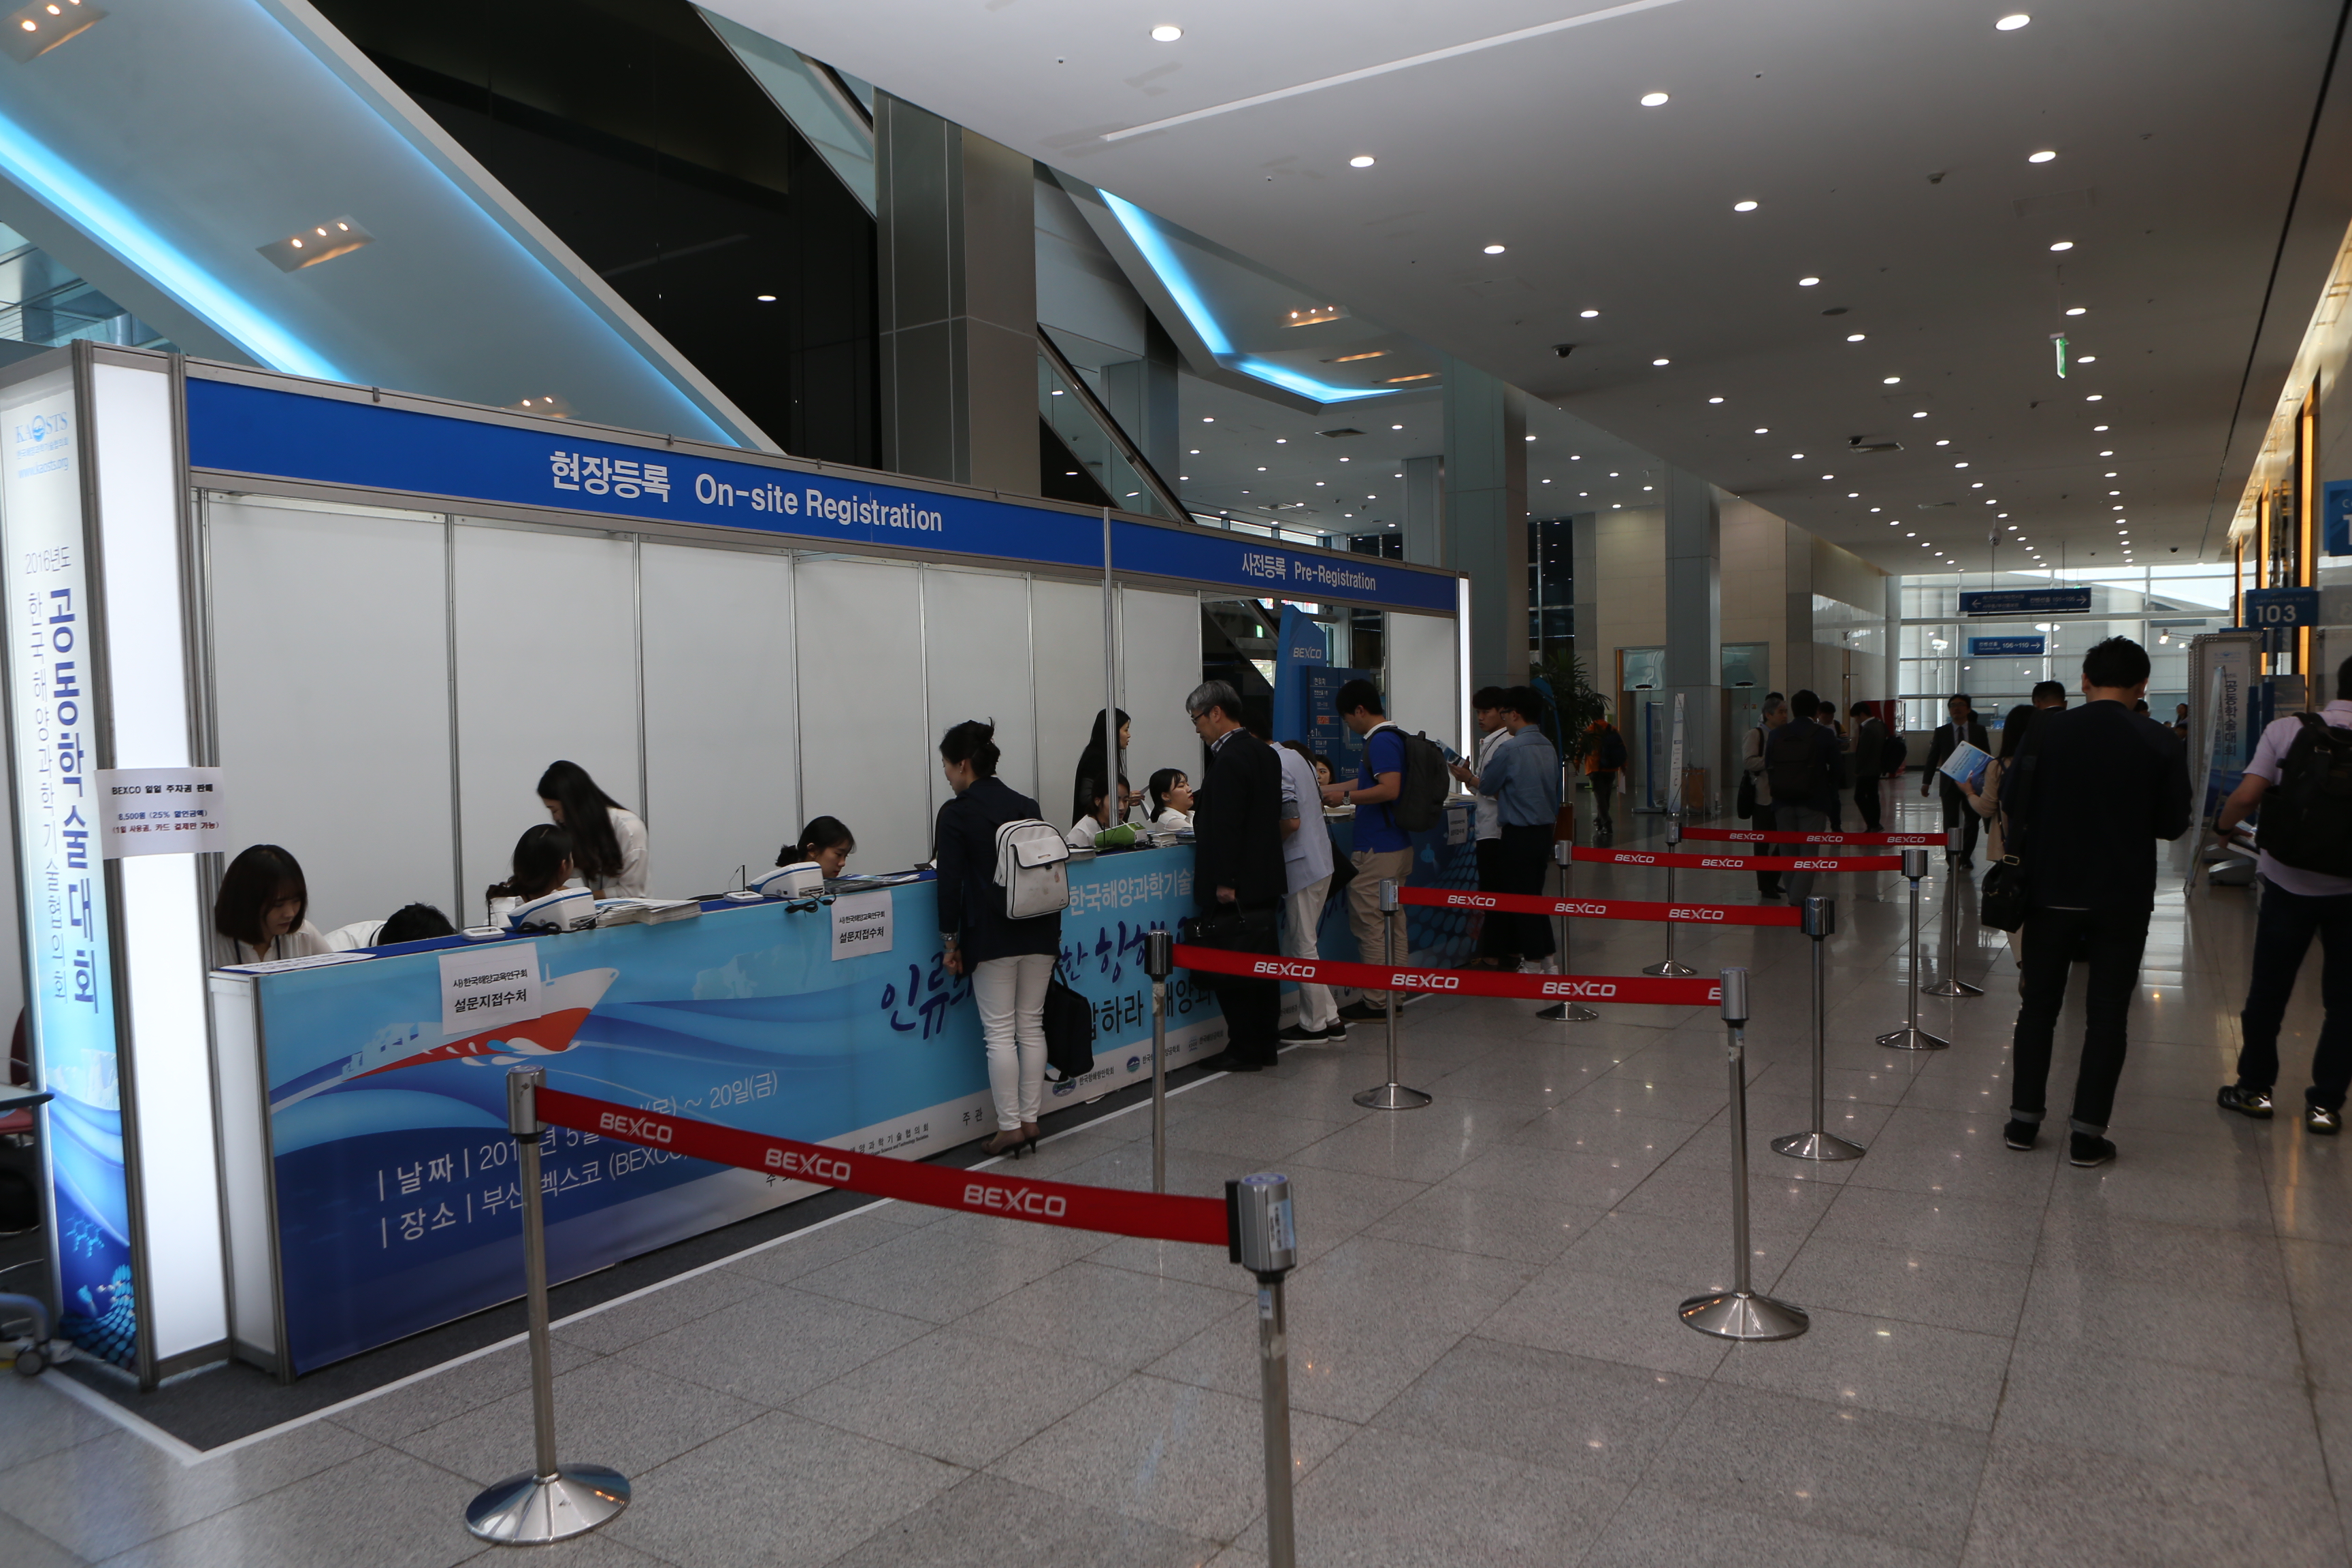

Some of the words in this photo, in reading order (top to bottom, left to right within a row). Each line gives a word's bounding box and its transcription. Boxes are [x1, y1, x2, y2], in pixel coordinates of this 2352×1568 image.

[15, 412, 68, 443] KAOSTS
[550, 450, 671, 503] 현장등록
[695, 473, 798, 515] On-site
[806, 488, 943, 532] Registration
[25, 546, 71, 575] 2016년도
[1242, 552, 1286, 581] 사전등록
[1294, 561, 1376, 591] Pre-Registration
[2255, 604, 2297, 623] 103
[1293, 647, 1322, 659] BEXCO
[28, 592, 68, 1004] 한국해양과학기술협의회
[49, 587, 99, 1013] 공동학술대회
[112, 787, 142, 795] BEXCO
[149, 811, 170, 819] (25%
[1729, 832, 1765, 840] BEXCO
[1806, 834, 1844, 843] BEXCO
[1614, 853, 1655, 864] BEXCO
[1701, 858, 1744, 868] BEXCO
[1793, 860, 1838, 869] BEXCO
[1069, 868, 1196, 916] 한국해양과학기술
[1447, 895, 1496, 907] BEXCO
[1554, 902, 1607, 915] BEXCO
[1669, 908, 1725, 920] BEXCO
[839, 926, 884, 944] 설문지접수처
[1253, 961, 1316, 978] BEXCO
[1391, 973, 1459, 989] BEXCO
[1541, 981, 1616, 997] BEXCO
[455, 988, 527, 1013] 설문지접수처
[479, 1126, 557, 1170] 201년
[709, 1070, 778, 1109] 20일(금)
[600, 1112, 672, 1143] BEXCO
[765, 1148, 851, 1181] BEXCO
[963, 1183, 1066, 1218] BEXCO
